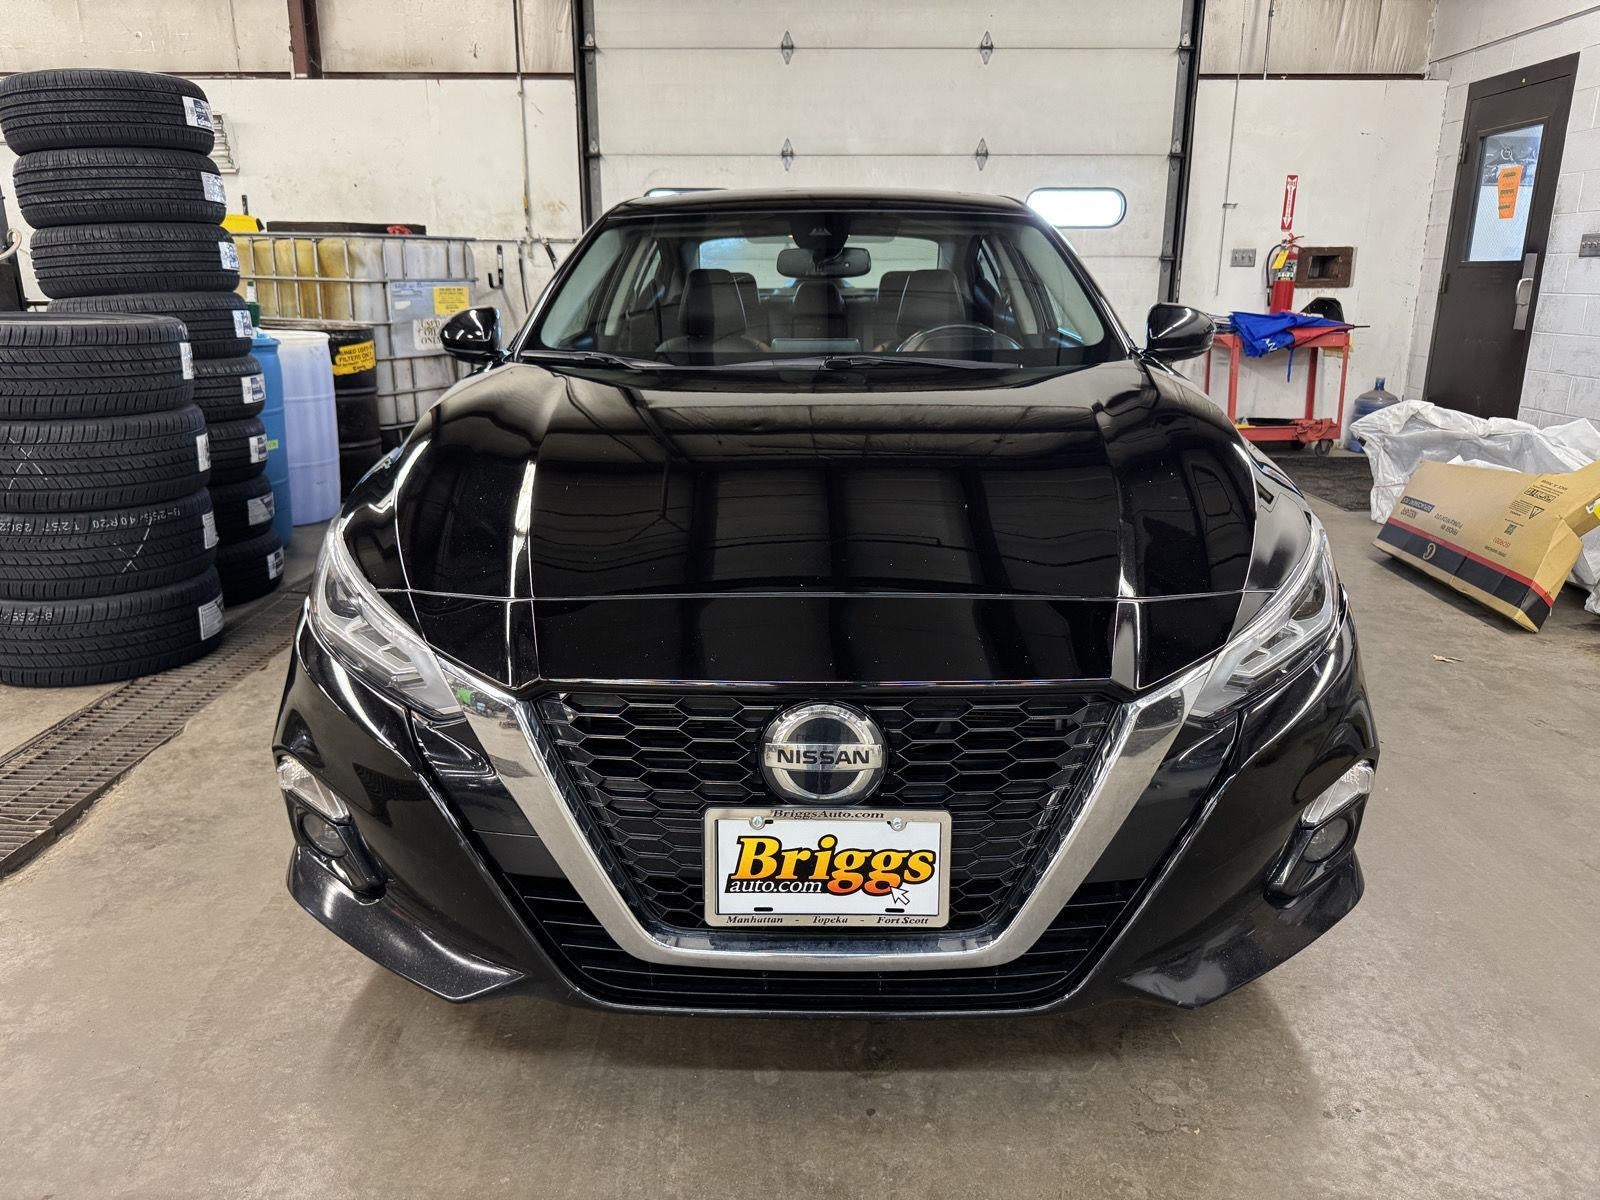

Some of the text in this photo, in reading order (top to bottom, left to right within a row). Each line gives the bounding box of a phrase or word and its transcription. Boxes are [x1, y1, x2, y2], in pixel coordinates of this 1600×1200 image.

[777, 749, 870, 764] NISSAN
[772, 809, 885, 819] BriggsAuto.com
[729, 834, 936, 895] Briggs
[729, 880, 822, 893] auto.com
[726, 916, 783, 924] Manhattan
[812, 916, 848, 926] Topeka
[876, 916, 900, 925] Fort
[901, 916, 929, 925] Scott
